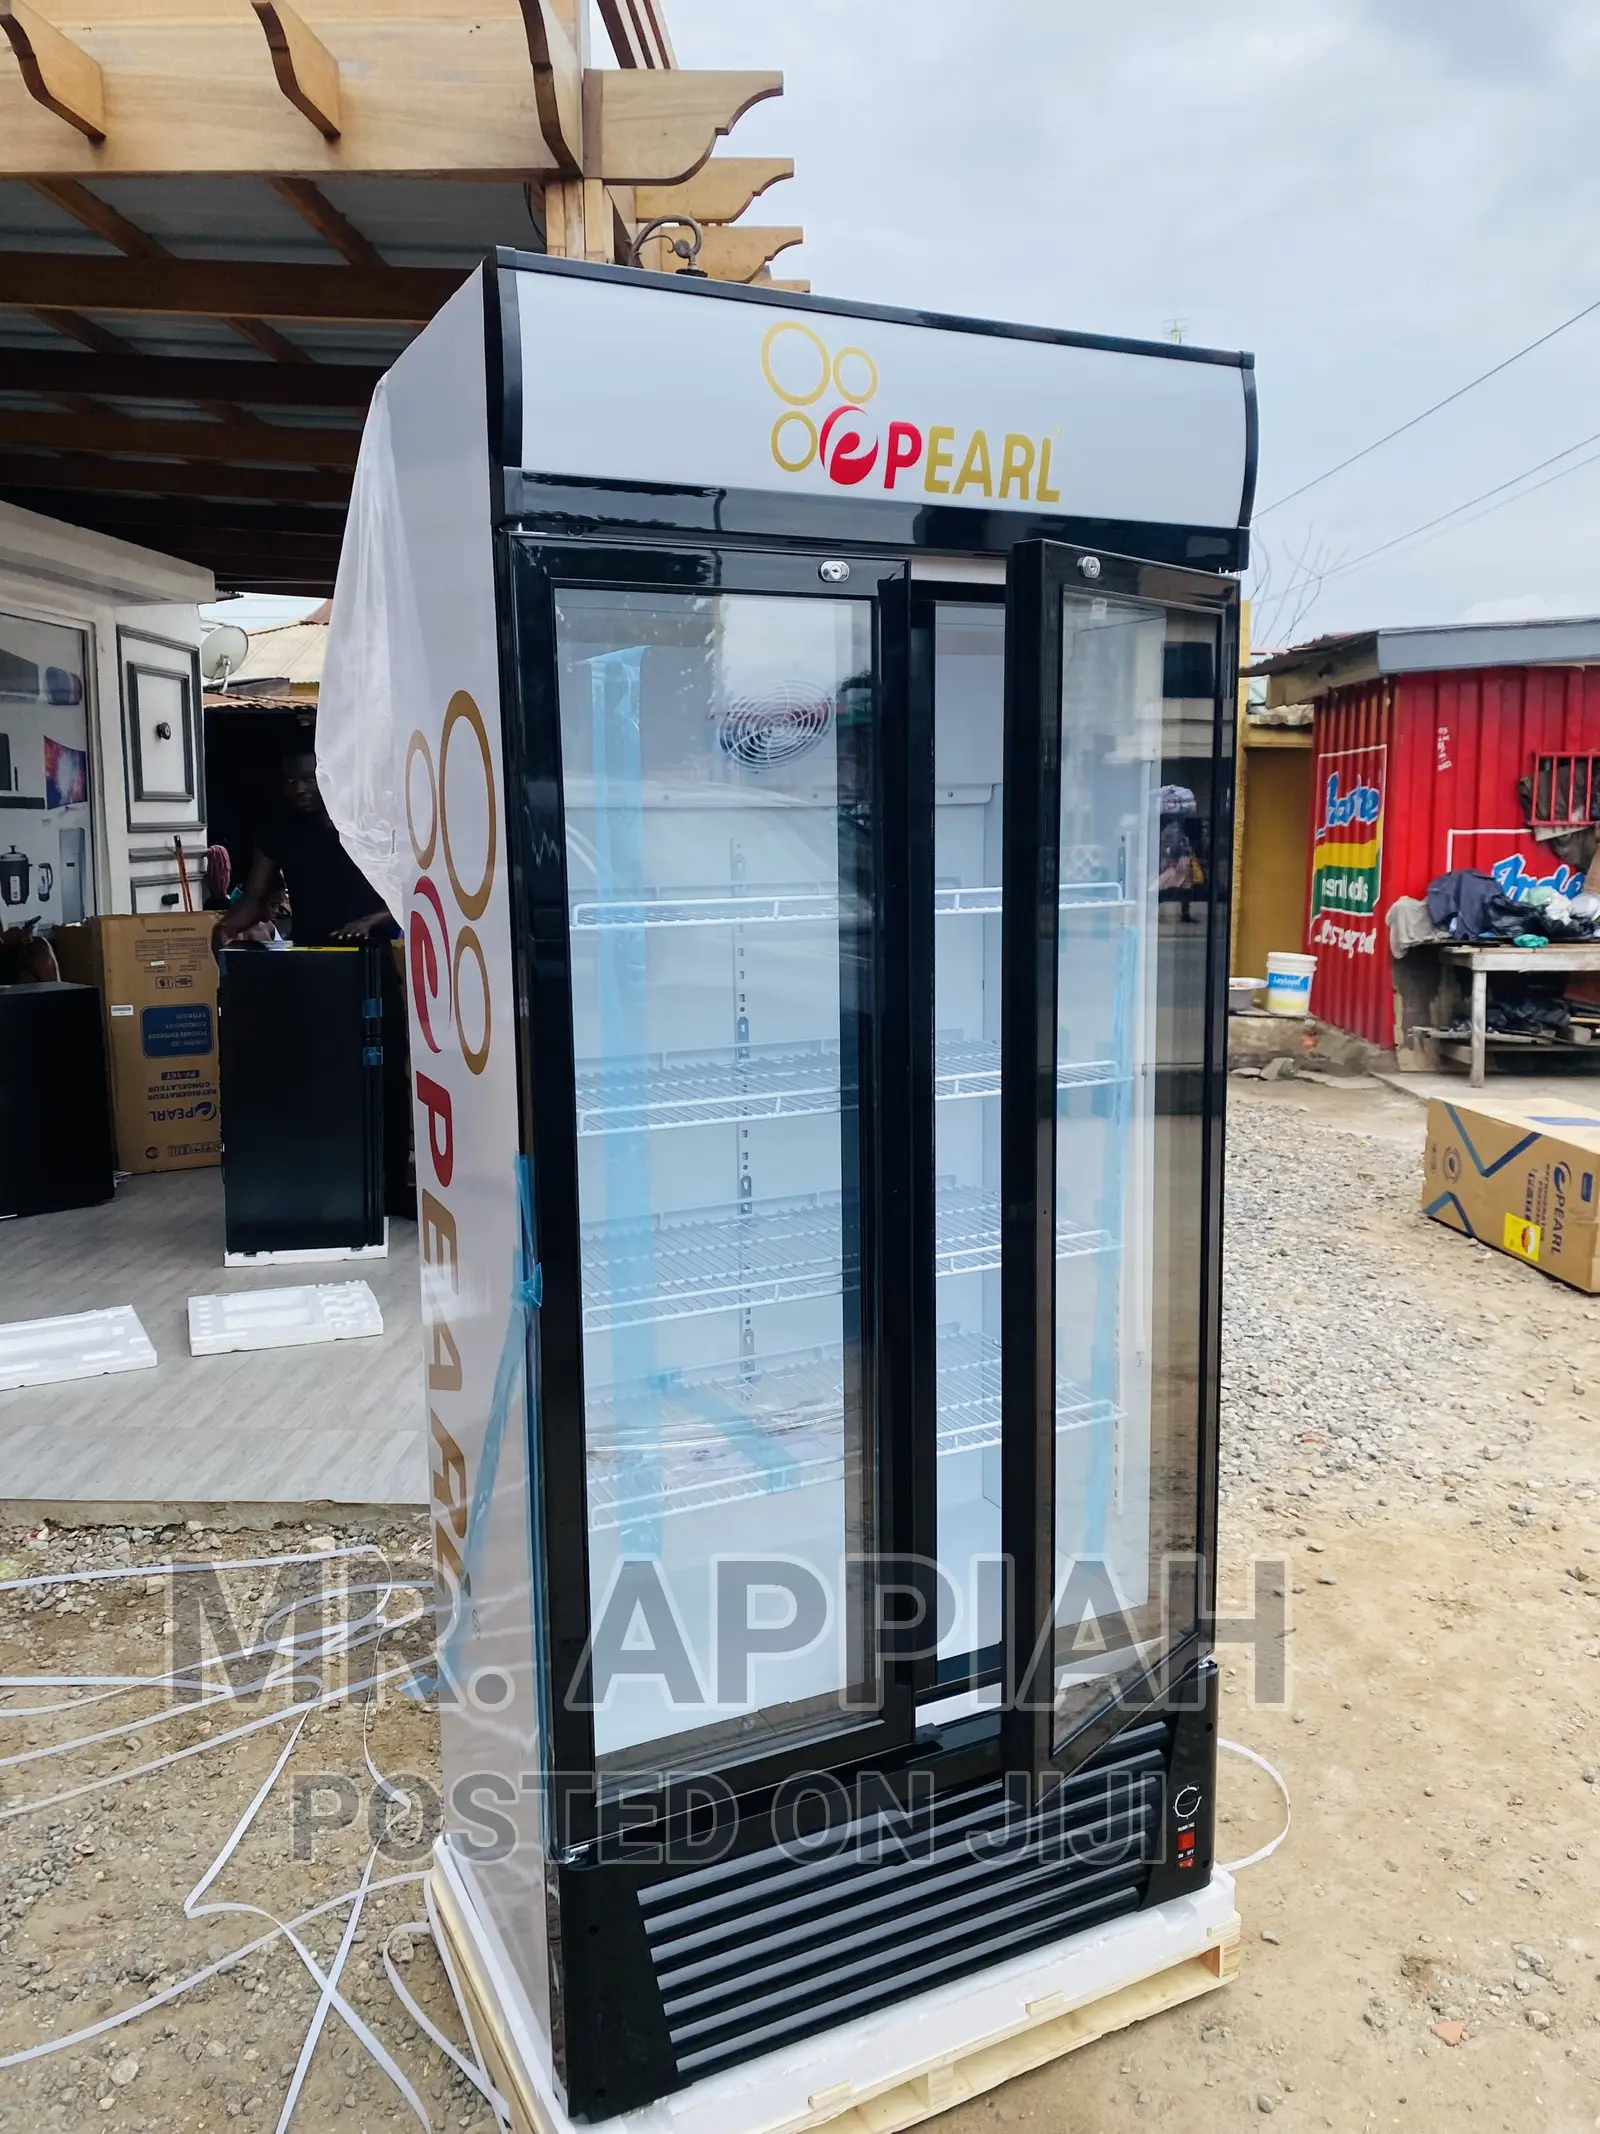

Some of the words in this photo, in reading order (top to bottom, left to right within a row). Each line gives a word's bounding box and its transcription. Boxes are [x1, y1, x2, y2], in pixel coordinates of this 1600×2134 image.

[884, 421, 1061, 502] PEARL
[148, 1106, 194, 1122] PEARL
[1551, 1193, 1566, 1255] PEARL
